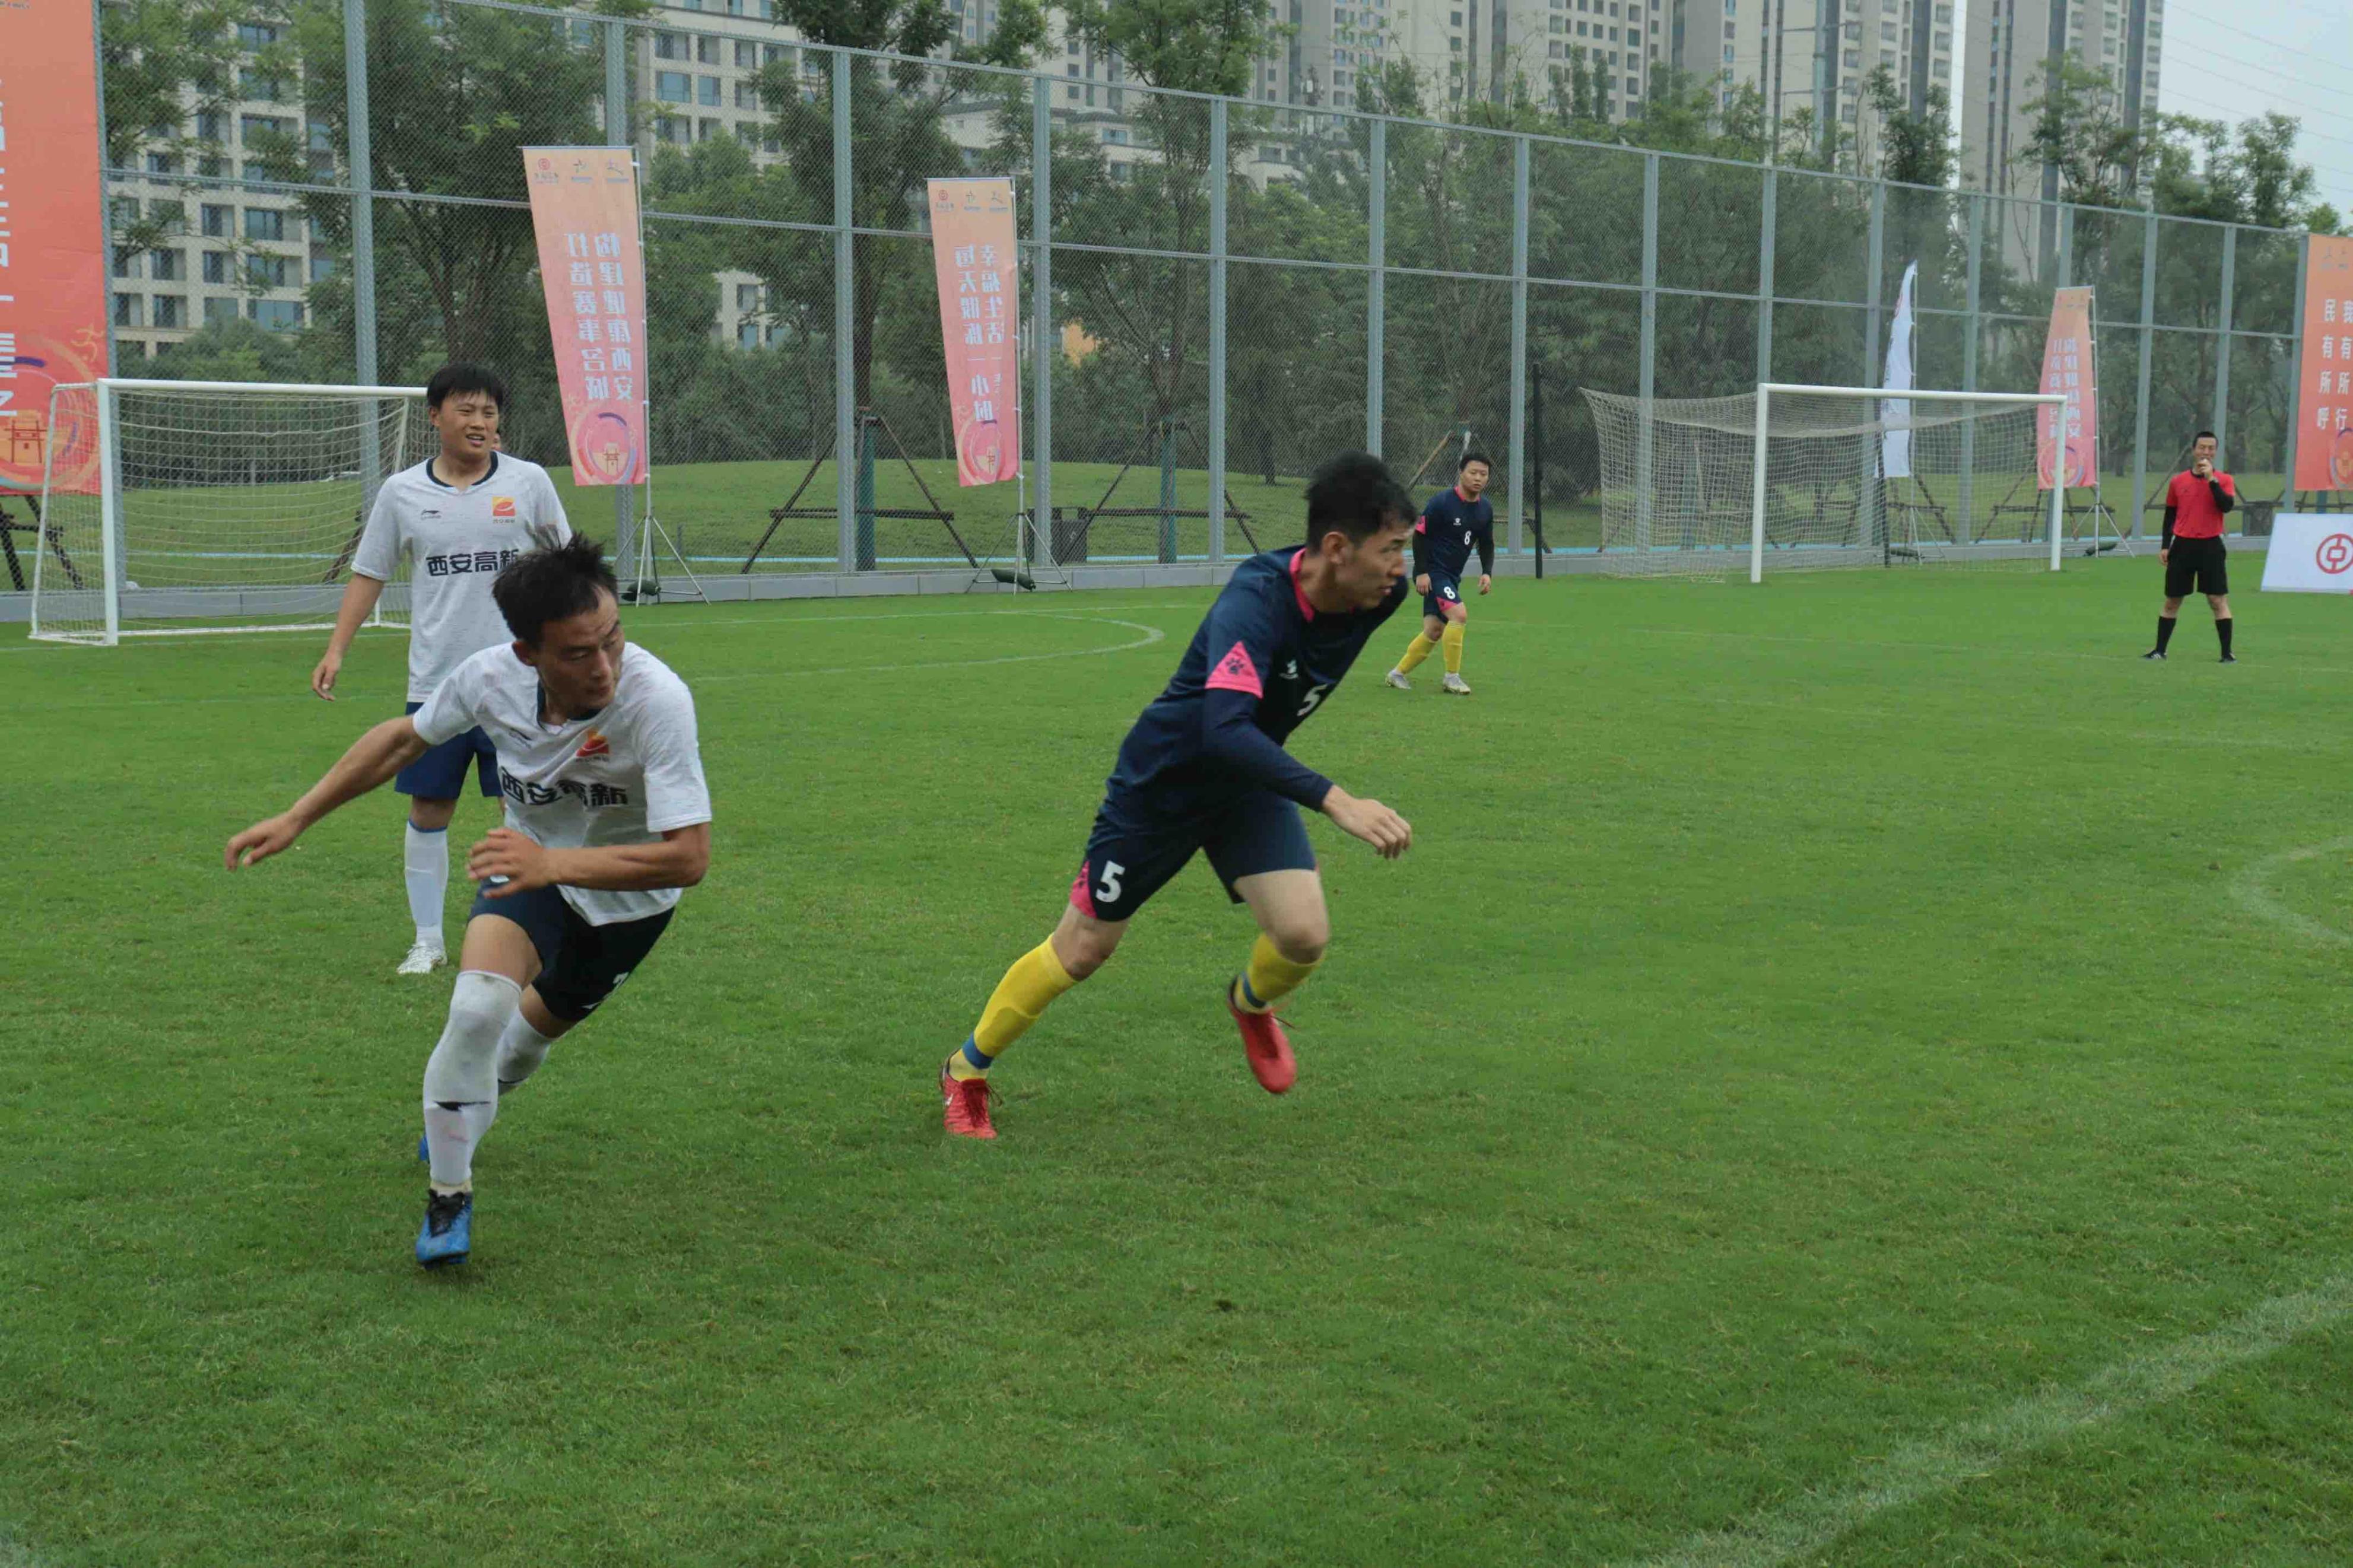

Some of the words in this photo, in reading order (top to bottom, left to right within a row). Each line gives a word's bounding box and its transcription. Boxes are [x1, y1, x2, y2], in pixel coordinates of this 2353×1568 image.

[2317, 298, 2336, 430] 民有所呼
[1464, 531, 1471, 545] 8
[426, 549, 519, 577] 西安高新
[1444, 586, 1456, 599] 8
[1297, 684, 1328, 716] 5
[1095, 860, 1125, 902] 5
